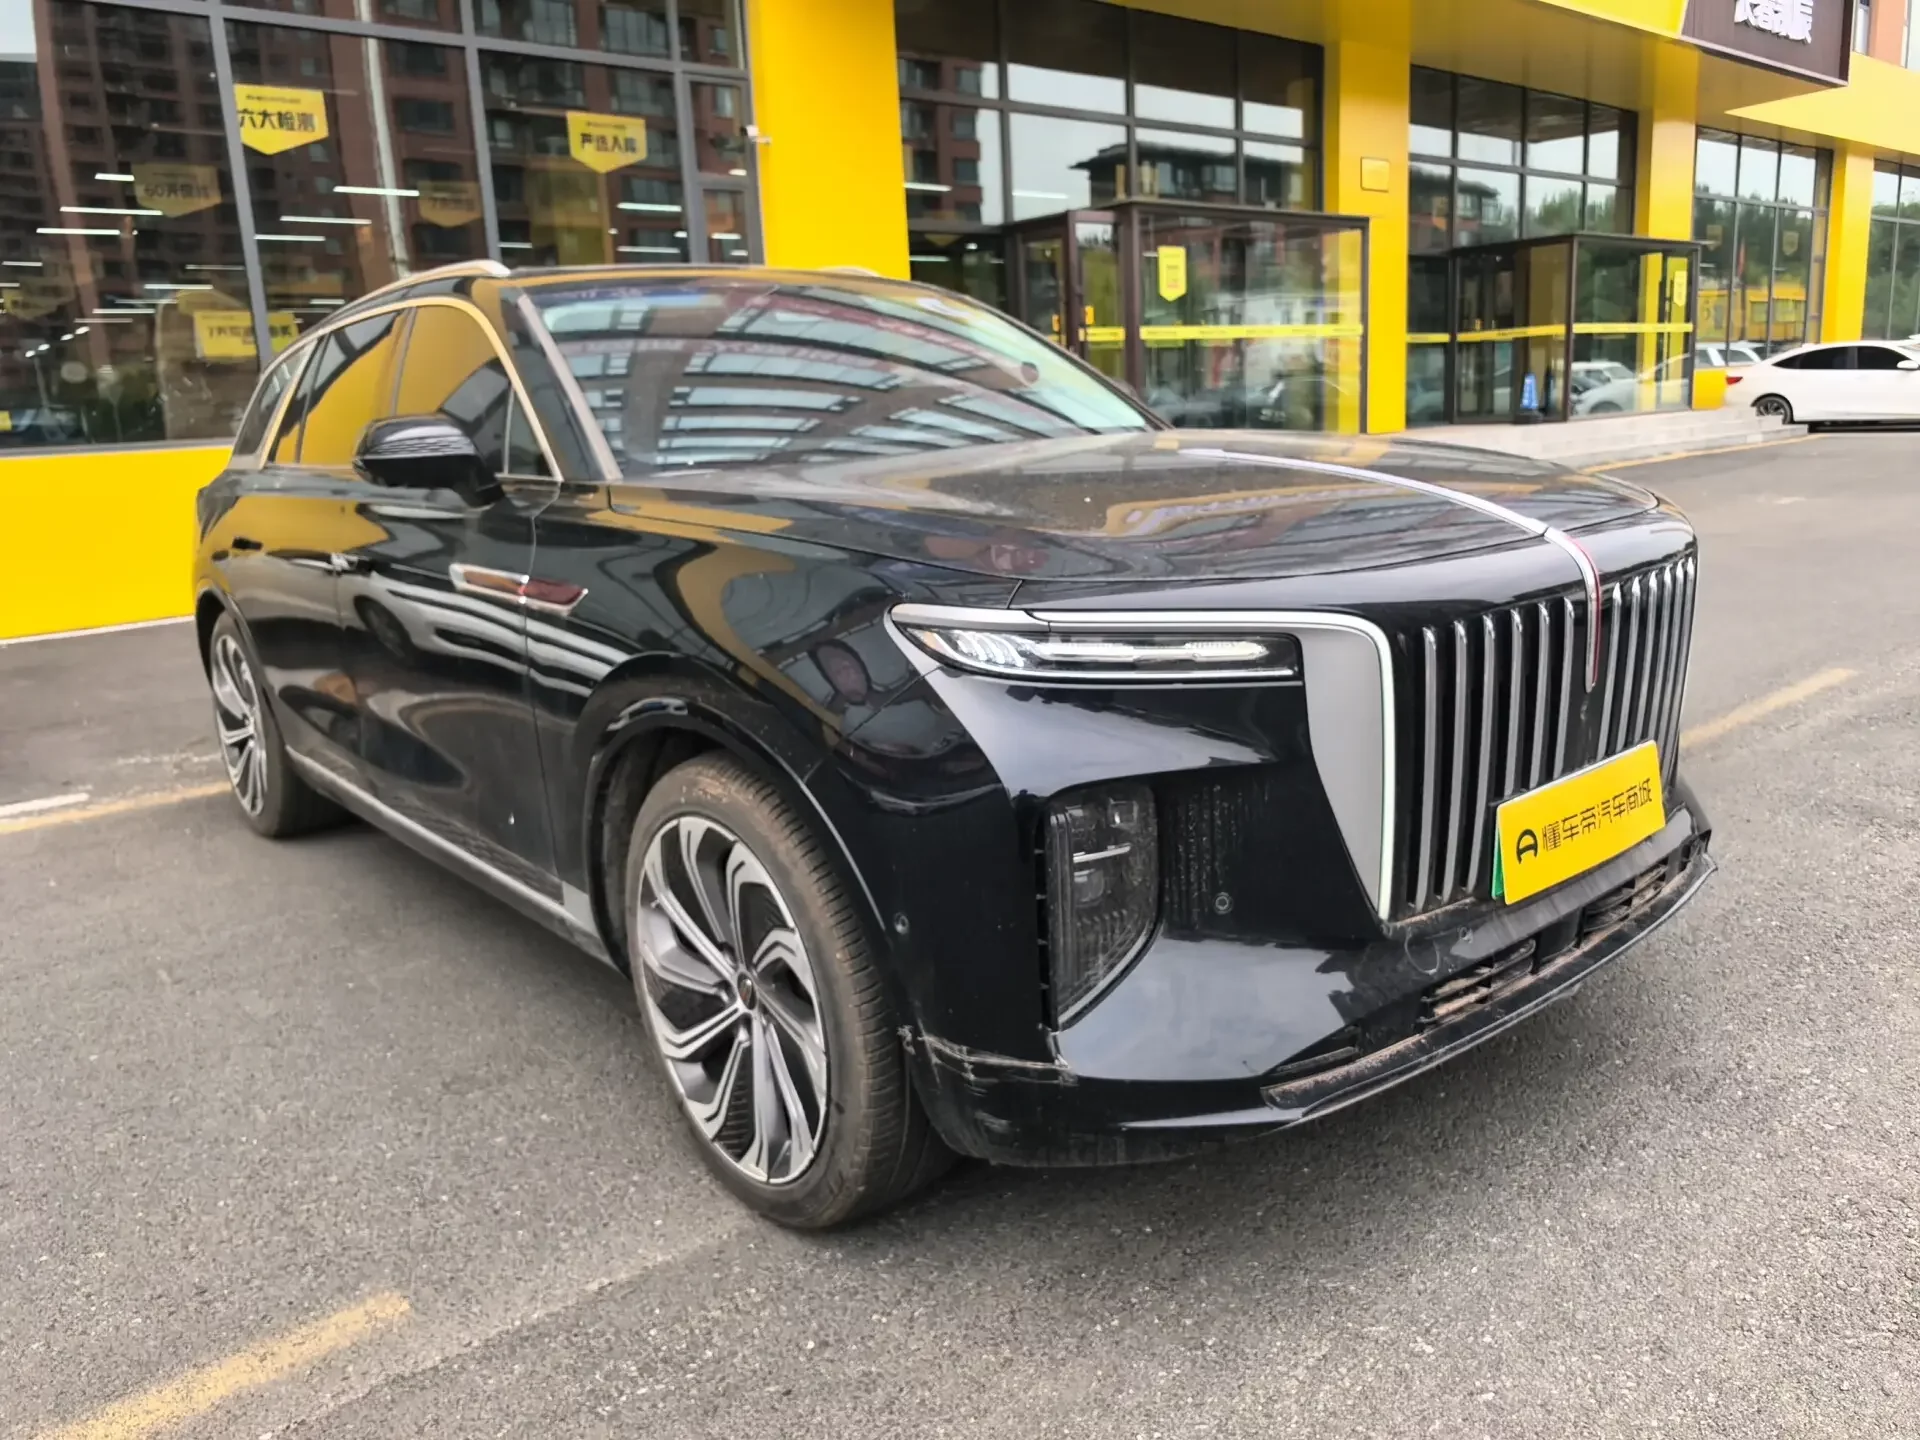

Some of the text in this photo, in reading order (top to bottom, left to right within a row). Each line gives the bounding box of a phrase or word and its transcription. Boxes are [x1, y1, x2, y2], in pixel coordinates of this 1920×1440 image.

[237, 108, 316, 133] 六大检测
[1542, 778, 1652, 852] 懂车帝汽车商城
